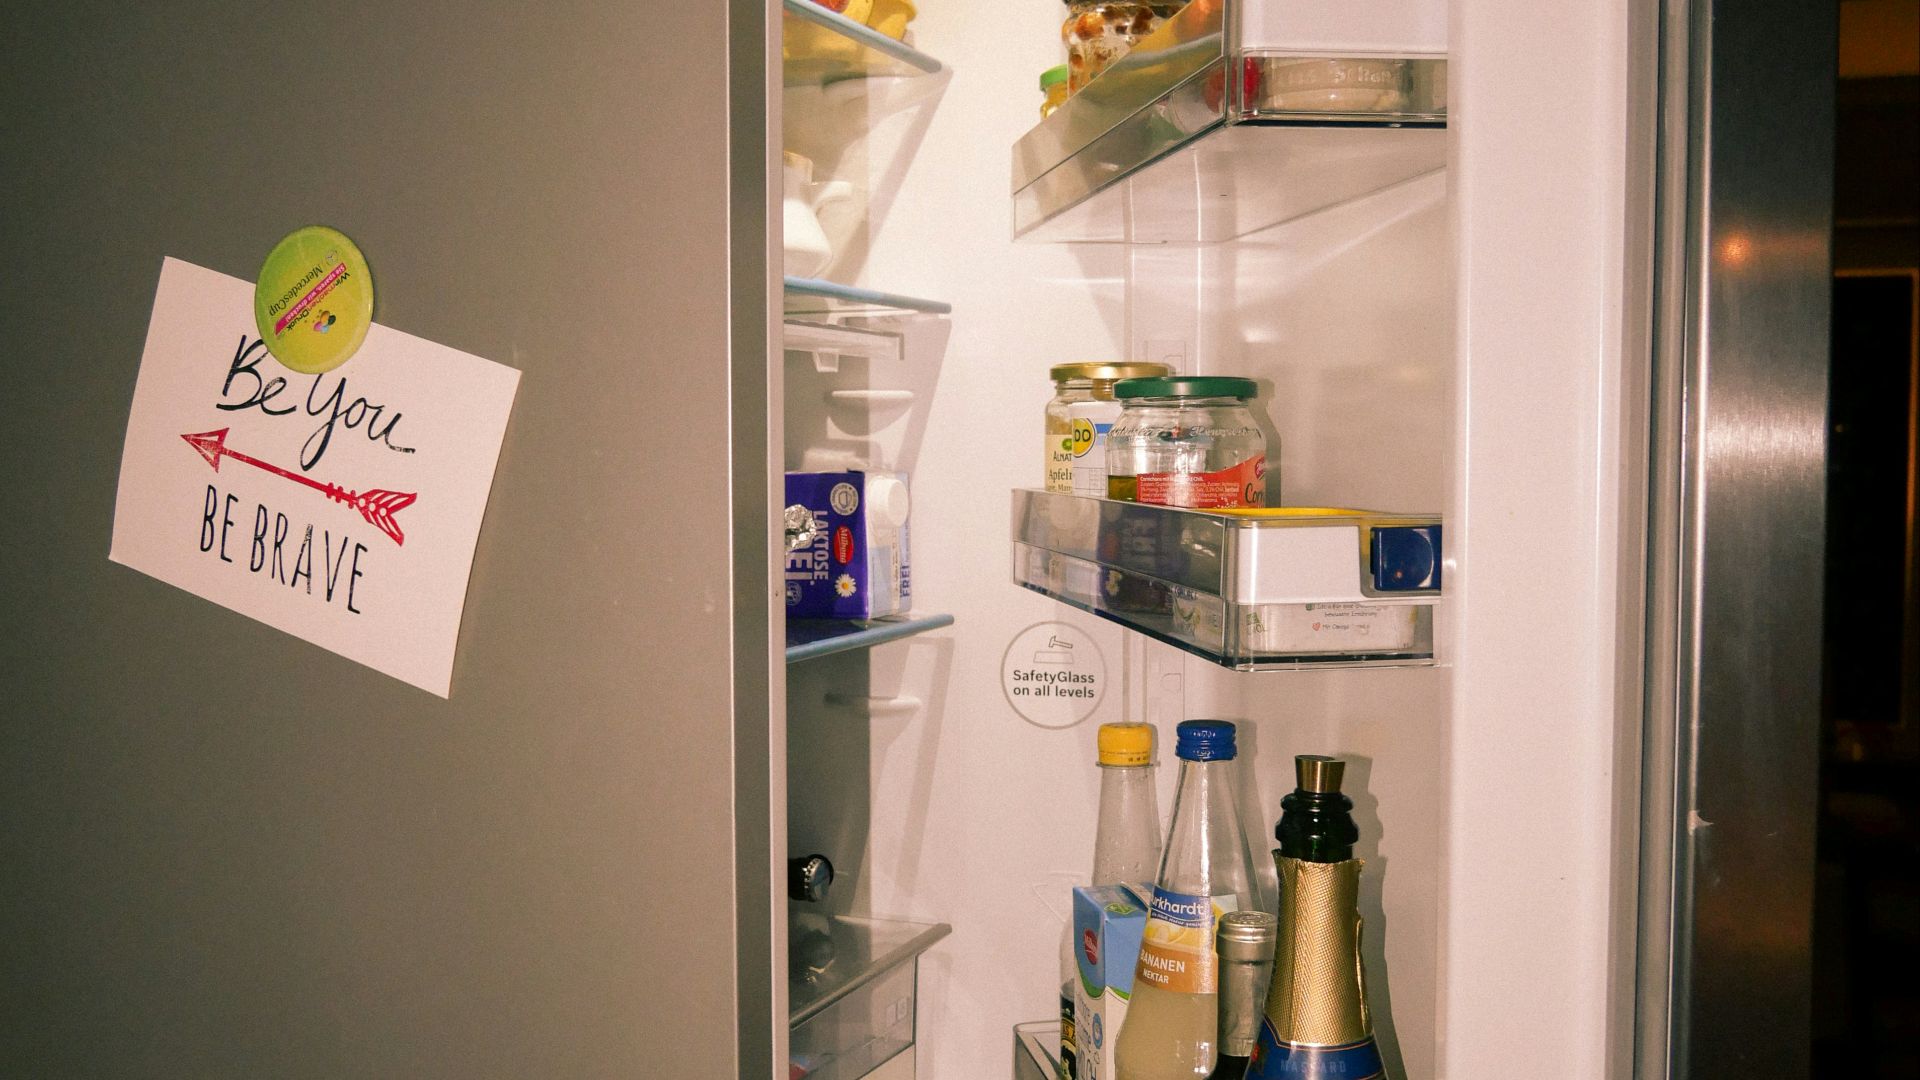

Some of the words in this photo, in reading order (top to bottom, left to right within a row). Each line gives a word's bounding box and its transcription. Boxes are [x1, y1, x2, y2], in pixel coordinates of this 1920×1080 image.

[269, 263, 323, 317] MercedesCup
[216, 334, 297, 415] Be
[300, 373, 416, 471] You
[200, 484, 239, 563] BE
[249, 503, 368, 614] BRAVE
[813, 510, 829, 580] LAKTOSE
[1013, 669, 1095, 684] SafetyGlass
[1013, 687, 1030, 696] on
[1034, 685, 1050, 696] all
[1055, 685, 1095, 698] levels
[1143, 968, 1169, 984] NEKTAR
